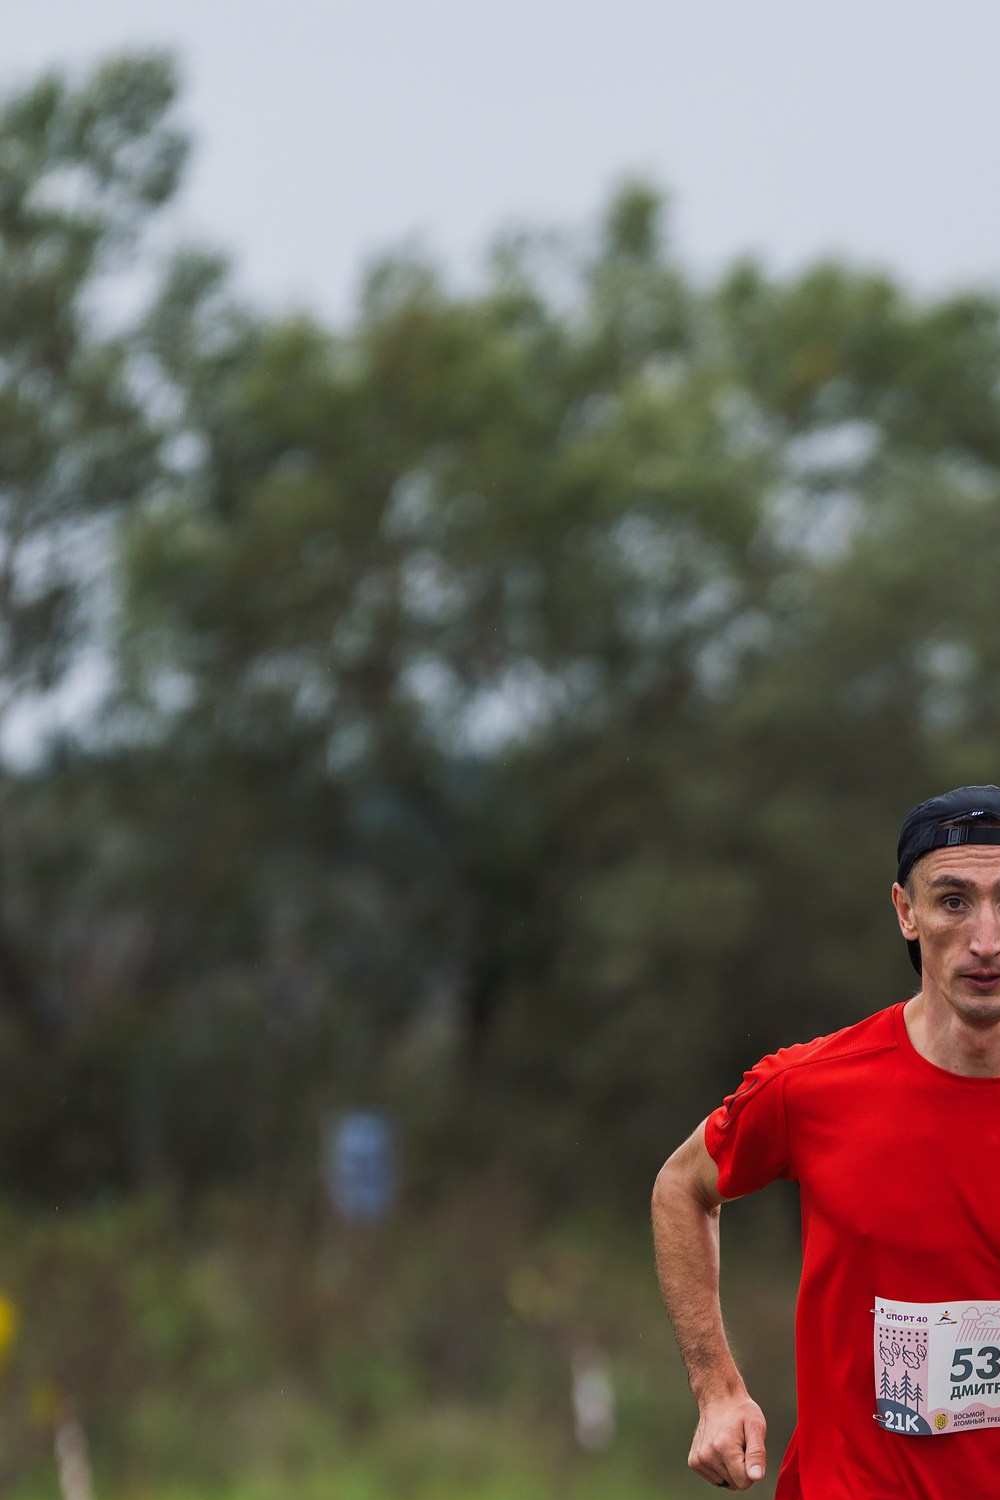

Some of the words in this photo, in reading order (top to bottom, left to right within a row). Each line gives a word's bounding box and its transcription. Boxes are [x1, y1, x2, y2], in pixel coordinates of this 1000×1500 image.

[886, 1313, 915, 1323] СПОРТ
[953, 1409, 985, 1421] ВОСЬМОЙ
[953, 1417, 986, 1427] АТОМНЫЙ
